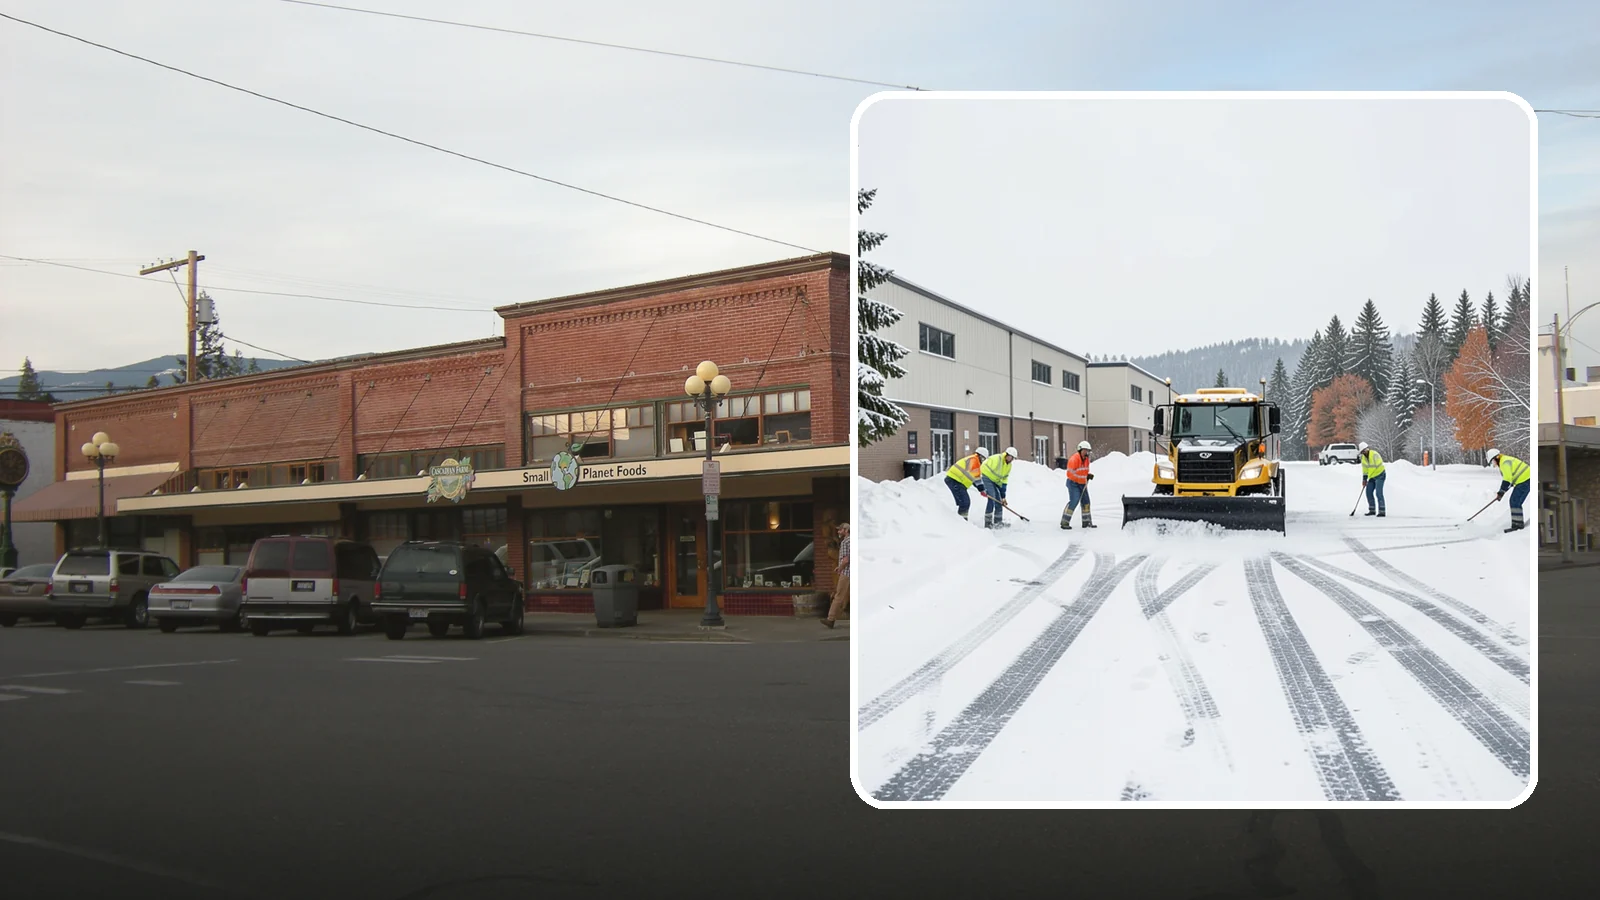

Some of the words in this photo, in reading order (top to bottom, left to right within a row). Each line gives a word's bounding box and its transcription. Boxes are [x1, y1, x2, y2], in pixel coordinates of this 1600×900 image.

[431, 466, 455, 476] CASCADIAN
[456, 465, 469, 474] FARM
[523, 471, 549, 483] Small
[582, 467, 614, 479] Planet
[616, 464, 647, 477] Foods
